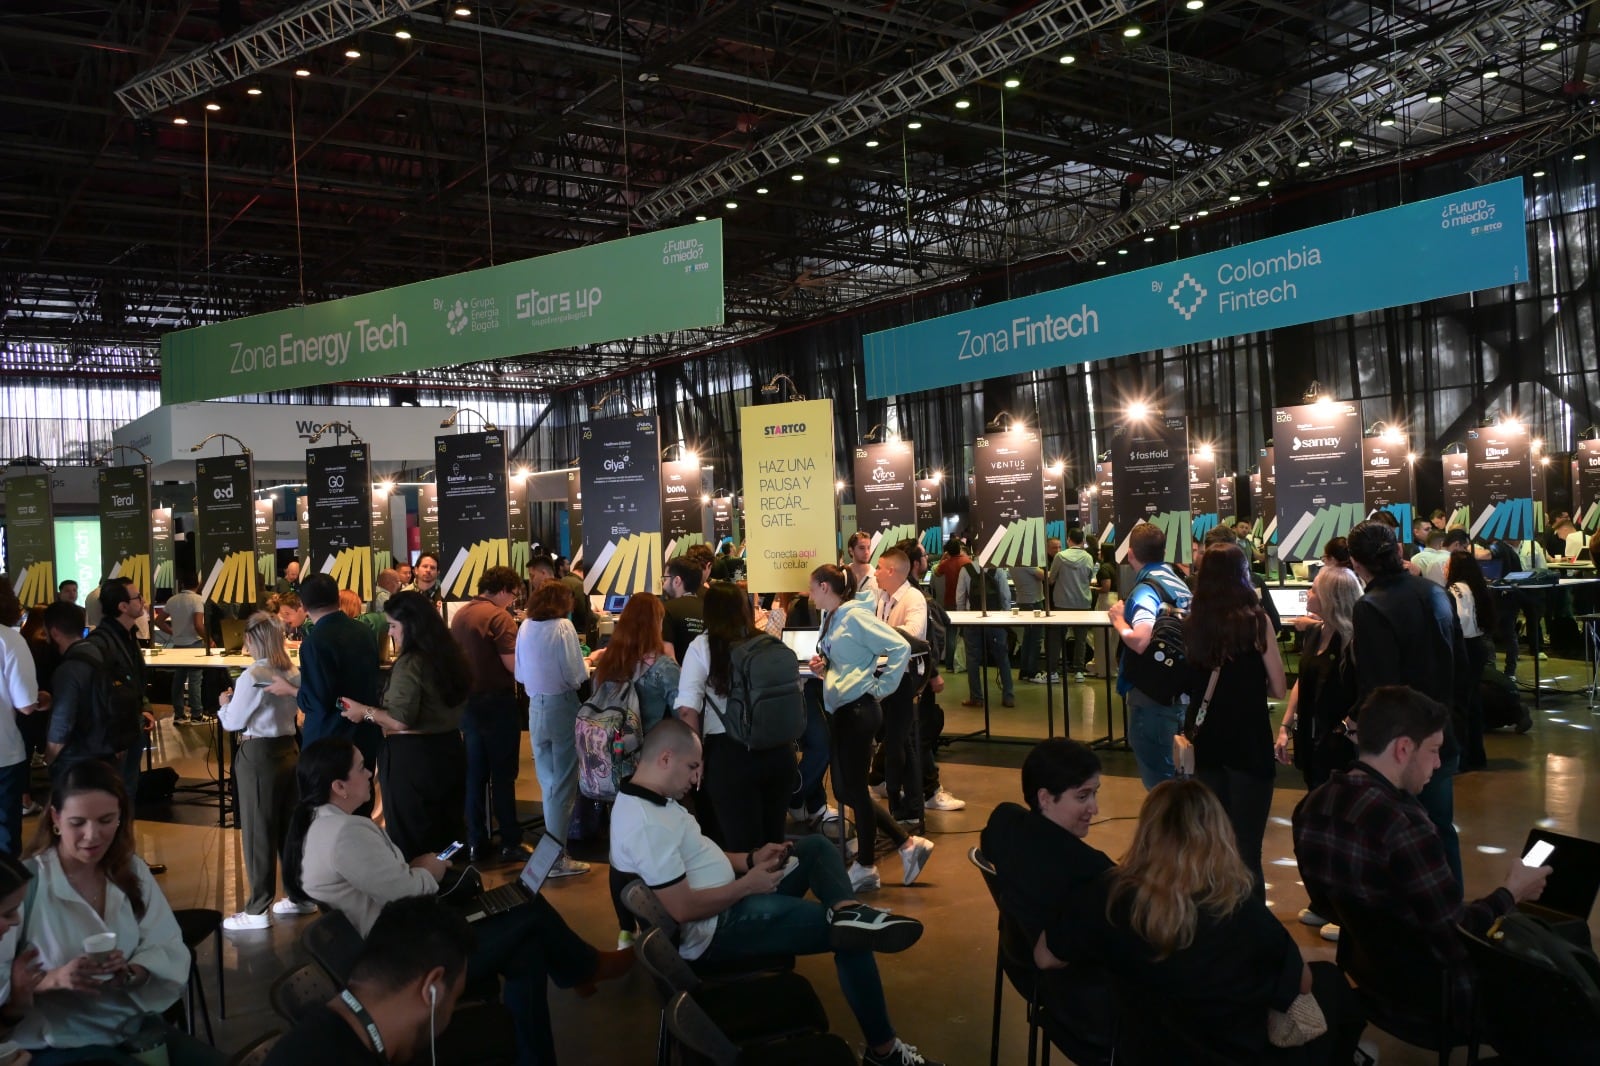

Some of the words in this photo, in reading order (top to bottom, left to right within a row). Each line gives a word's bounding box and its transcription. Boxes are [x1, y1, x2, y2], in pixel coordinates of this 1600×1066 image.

[1442, 220, 1450, 228] o
[1452, 207, 1496, 227] miedo?
[663, 256, 669, 264] o
[670, 248, 704, 263] miedo?
[1218, 245, 1322, 285] Colombia
[1151, 281, 1163, 293] By
[471, 297, 495, 309] Grupo
[516, 289, 570, 319] Stars
[576, 287, 602, 317] up
[1219, 280, 1297, 314] Fintech
[433, 298, 444, 311] By
[957, 329, 1009, 360] Zona
[1012, 304, 1099, 349] Fintech
[230, 342, 277, 374] Zona
[280, 331, 351, 366] Energy
[354, 314, 407, 353] Tech
[1276, 414, 1292, 423] B26
[296, 420, 352, 437] Wompi
[764, 423, 806, 436] STARTCO
[1302, 437, 1341, 448] samay
[1136, 449, 1169, 460] fastfold
[603, 459, 625, 473] Glya
[759, 459, 785, 473] HAZ
[787, 457, 816, 472] UNA
[328, 475, 344, 488] GO
[759, 477, 800, 492] PAUSA
[803, 476, 811, 490] Y
[761, 513, 796, 528] GATE.
[764, 550, 798, 559] Conecta
[774, 561, 782, 570] tu
[782, 560, 809, 569] celular
